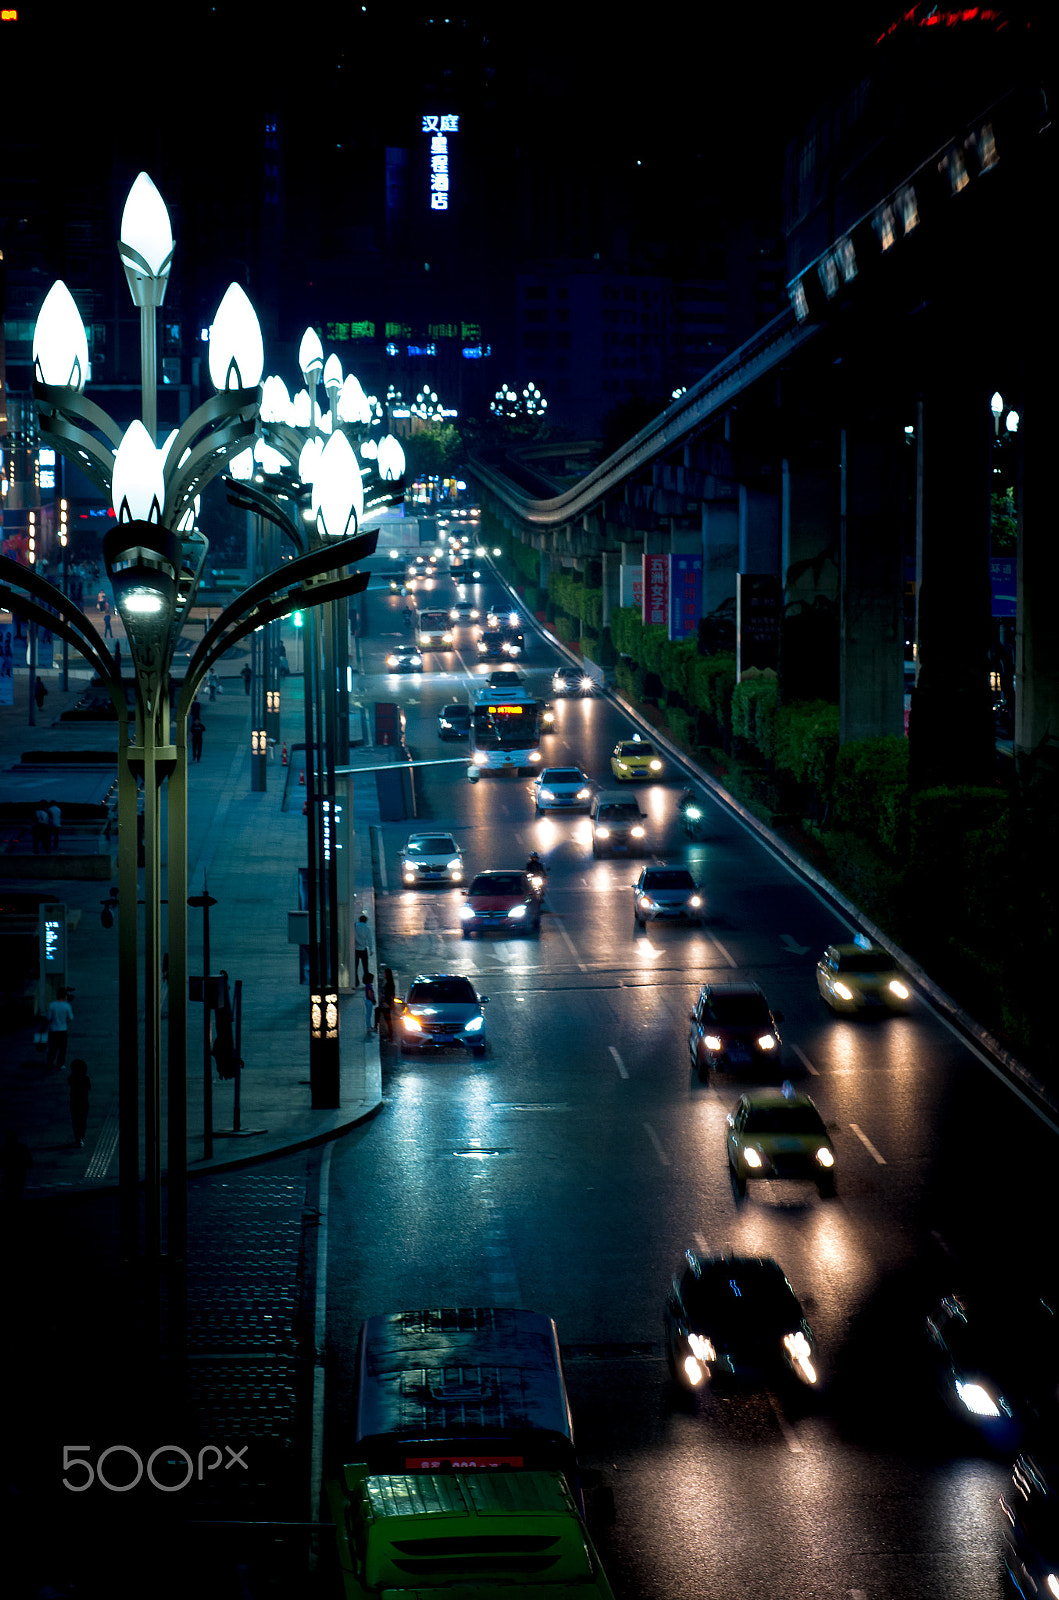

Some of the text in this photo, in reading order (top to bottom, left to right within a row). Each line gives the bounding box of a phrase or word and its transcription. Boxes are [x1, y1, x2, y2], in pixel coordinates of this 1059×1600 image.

[422, 114, 459, 132] 汉庭
[651, 558, 664, 625] 五洲女子医
